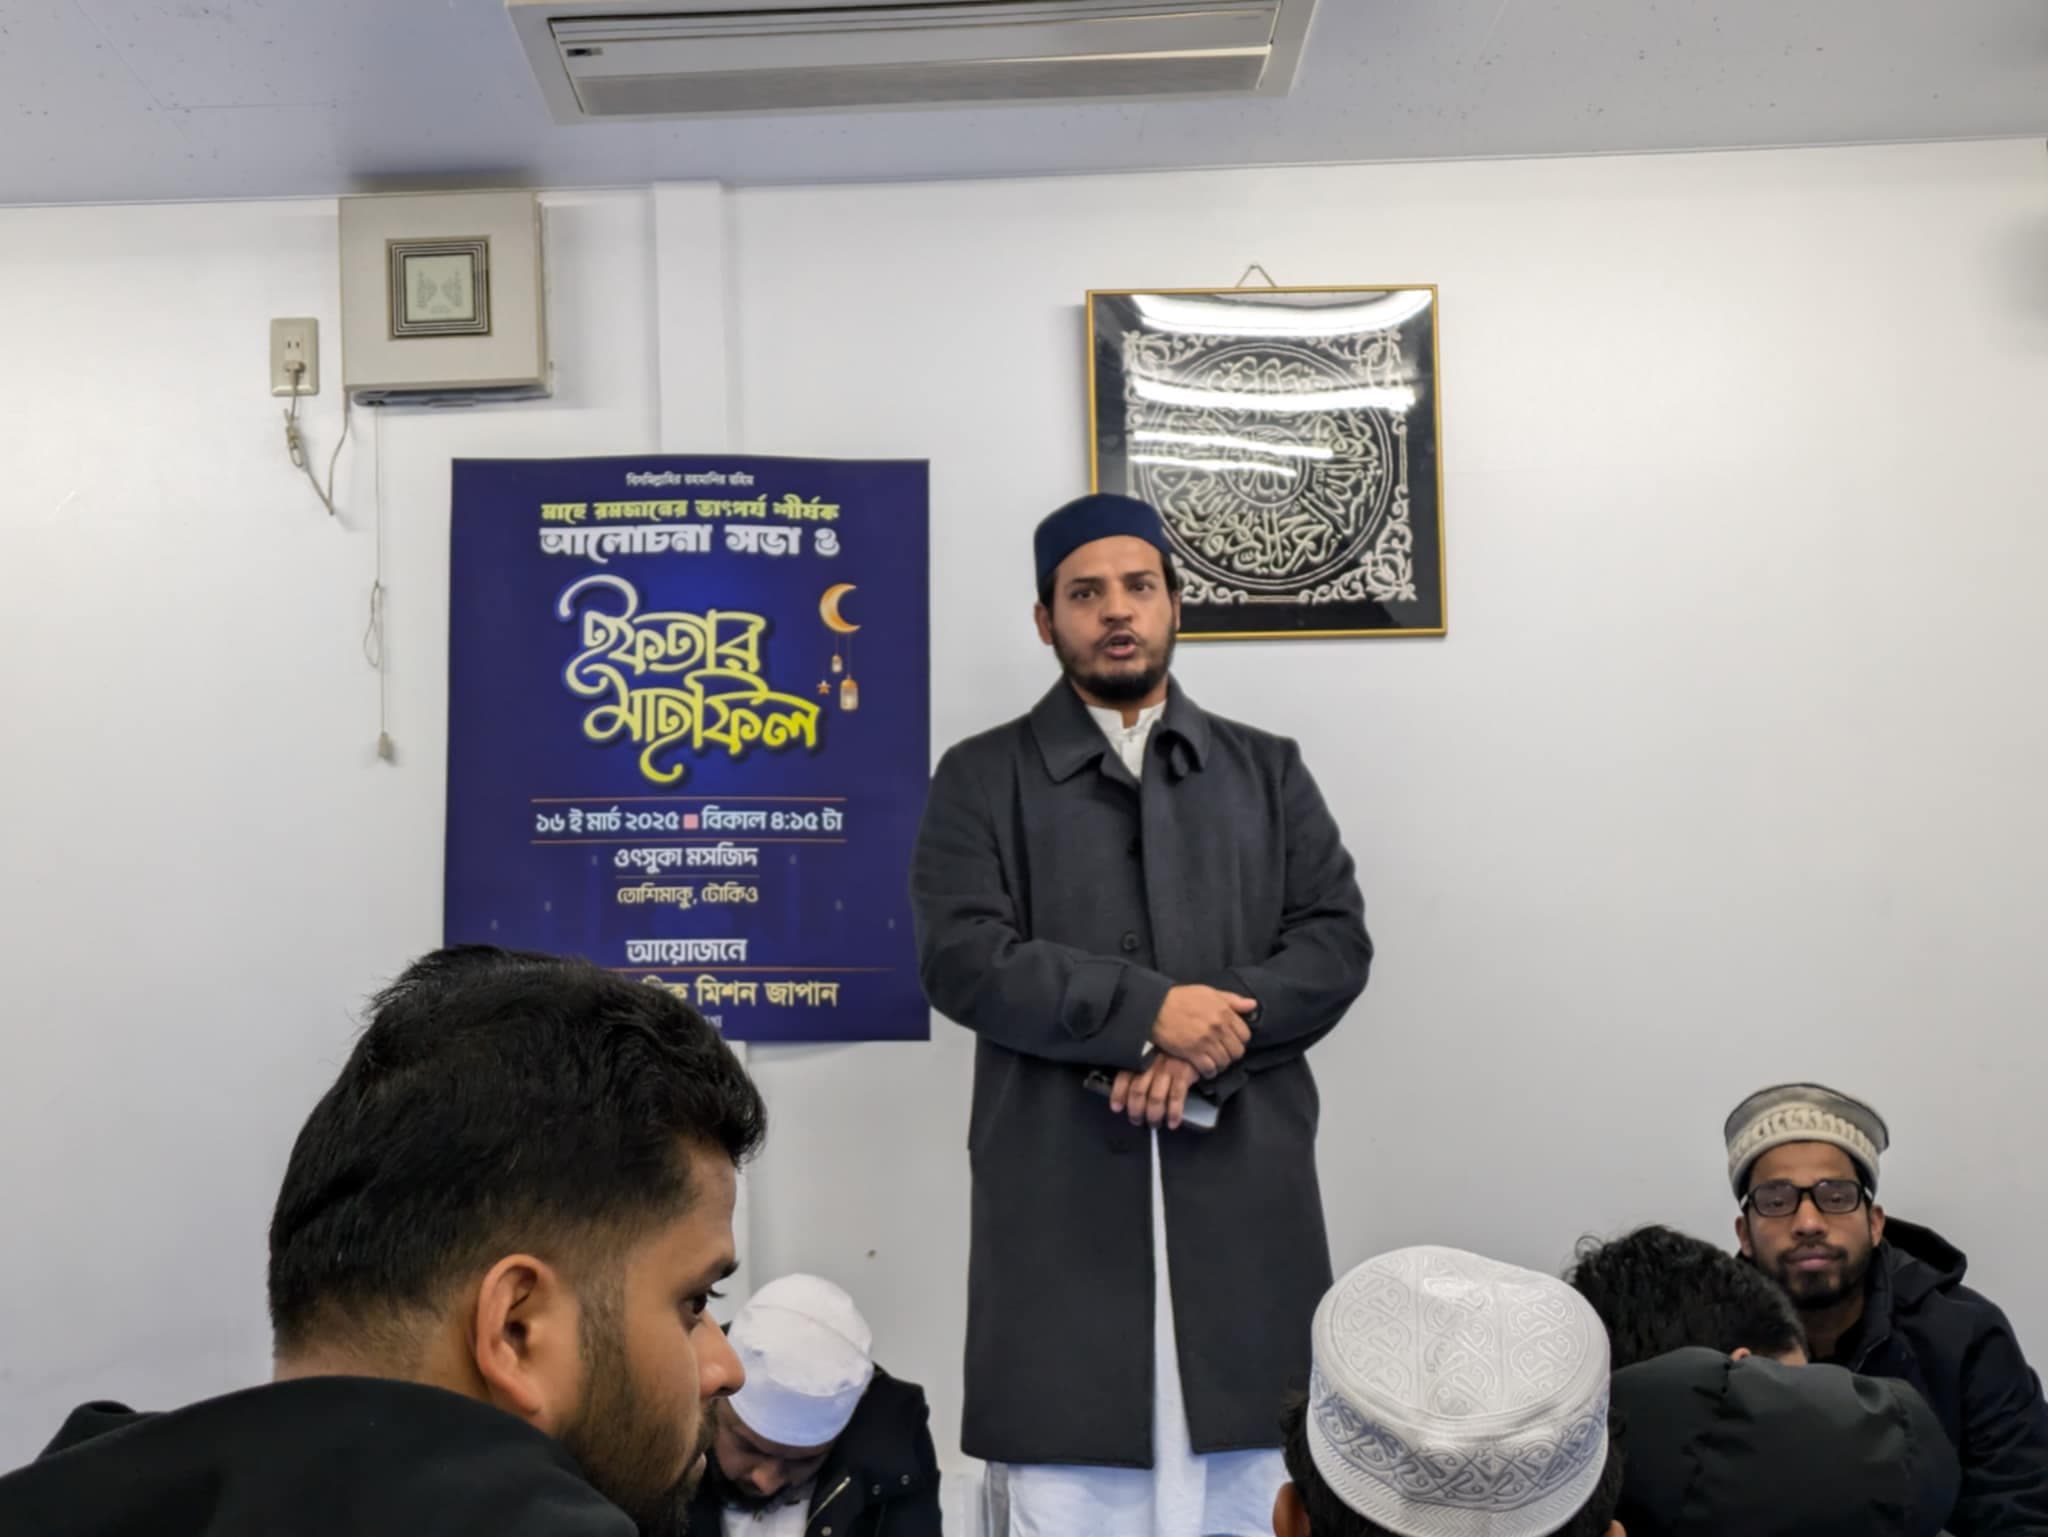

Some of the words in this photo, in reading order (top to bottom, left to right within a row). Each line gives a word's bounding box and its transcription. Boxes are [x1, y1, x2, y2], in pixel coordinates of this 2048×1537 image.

[541, 501, 587, 524] মাহে
[594, 499, 688, 523] রমজানের
[695, 494, 767, 519] তাৎপর্য
[773, 493, 840, 521] শীর্ষক
[540, 524, 712, 563] আলোচনা
[725, 525, 803, 556] সভা
[815, 528, 840, 557] ও
[558, 573, 767, 694] ইফতার
[583, 663, 820, 782] মাহফিল
[536, 813, 565, 832] ১৬
[569, 808, 584, 833] ই
[586, 807, 622, 831] মার্চ
[626, 811, 680, 831] ২০২৫
[701, 806, 767, 831] বিকাল
[771, 811, 818, 831] ৪:১৫
[822, 807, 843, 831] টা
[614, 847, 683, 875] ওৎসুকা
[686, 842, 758, 867] মসজিদ
[617, 882, 698, 909] তোশিমাকু,
[702, 882, 759, 904] টোকিও
[626, 938, 748, 966] আয়োজনে
[694, 973, 759, 1006] মিশন
[764, 979, 839, 1007] জাপান
